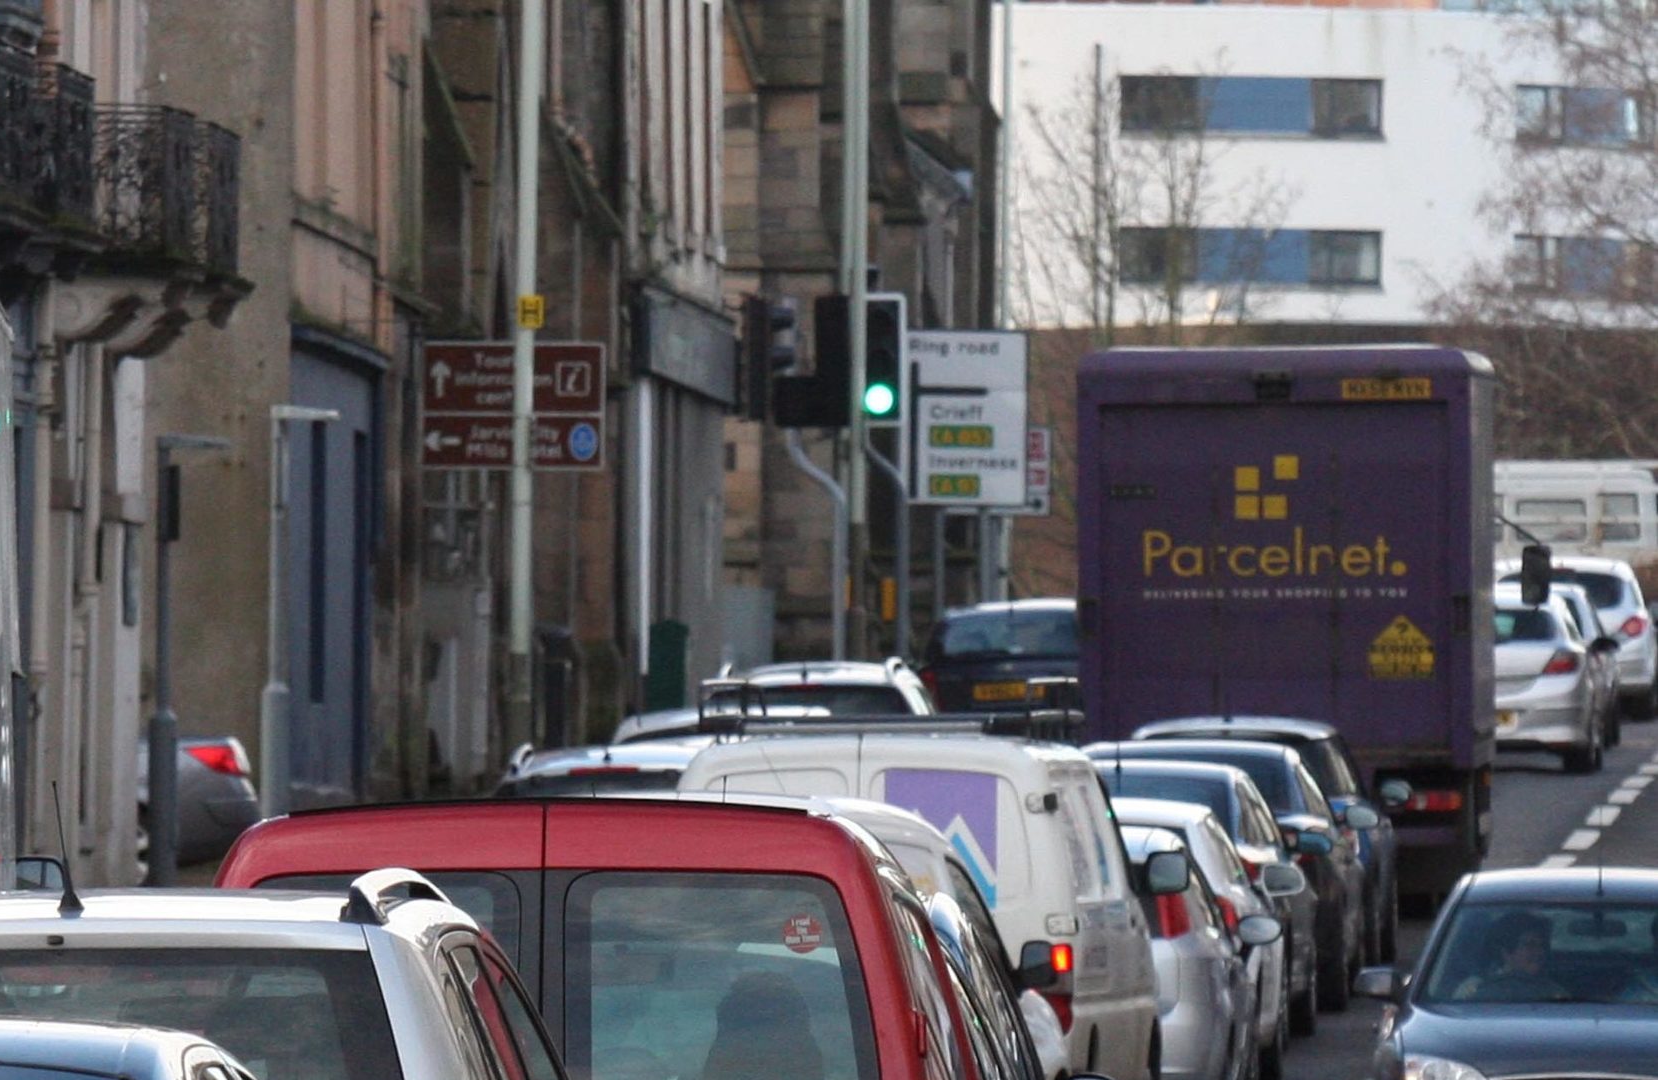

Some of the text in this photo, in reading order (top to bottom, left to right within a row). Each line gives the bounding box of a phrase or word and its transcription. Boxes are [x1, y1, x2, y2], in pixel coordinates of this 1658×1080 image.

[521, 300, 540, 326] H
[909, 339, 1000, 357] Ring road
[930, 405, 983, 420] Crieff
[930, 455, 1017, 469] Inverness
[1232, 588, 1270, 600] YOUR
[1355, 588, 1373, 599] TO
[1380, 587, 1408, 599] YOU
